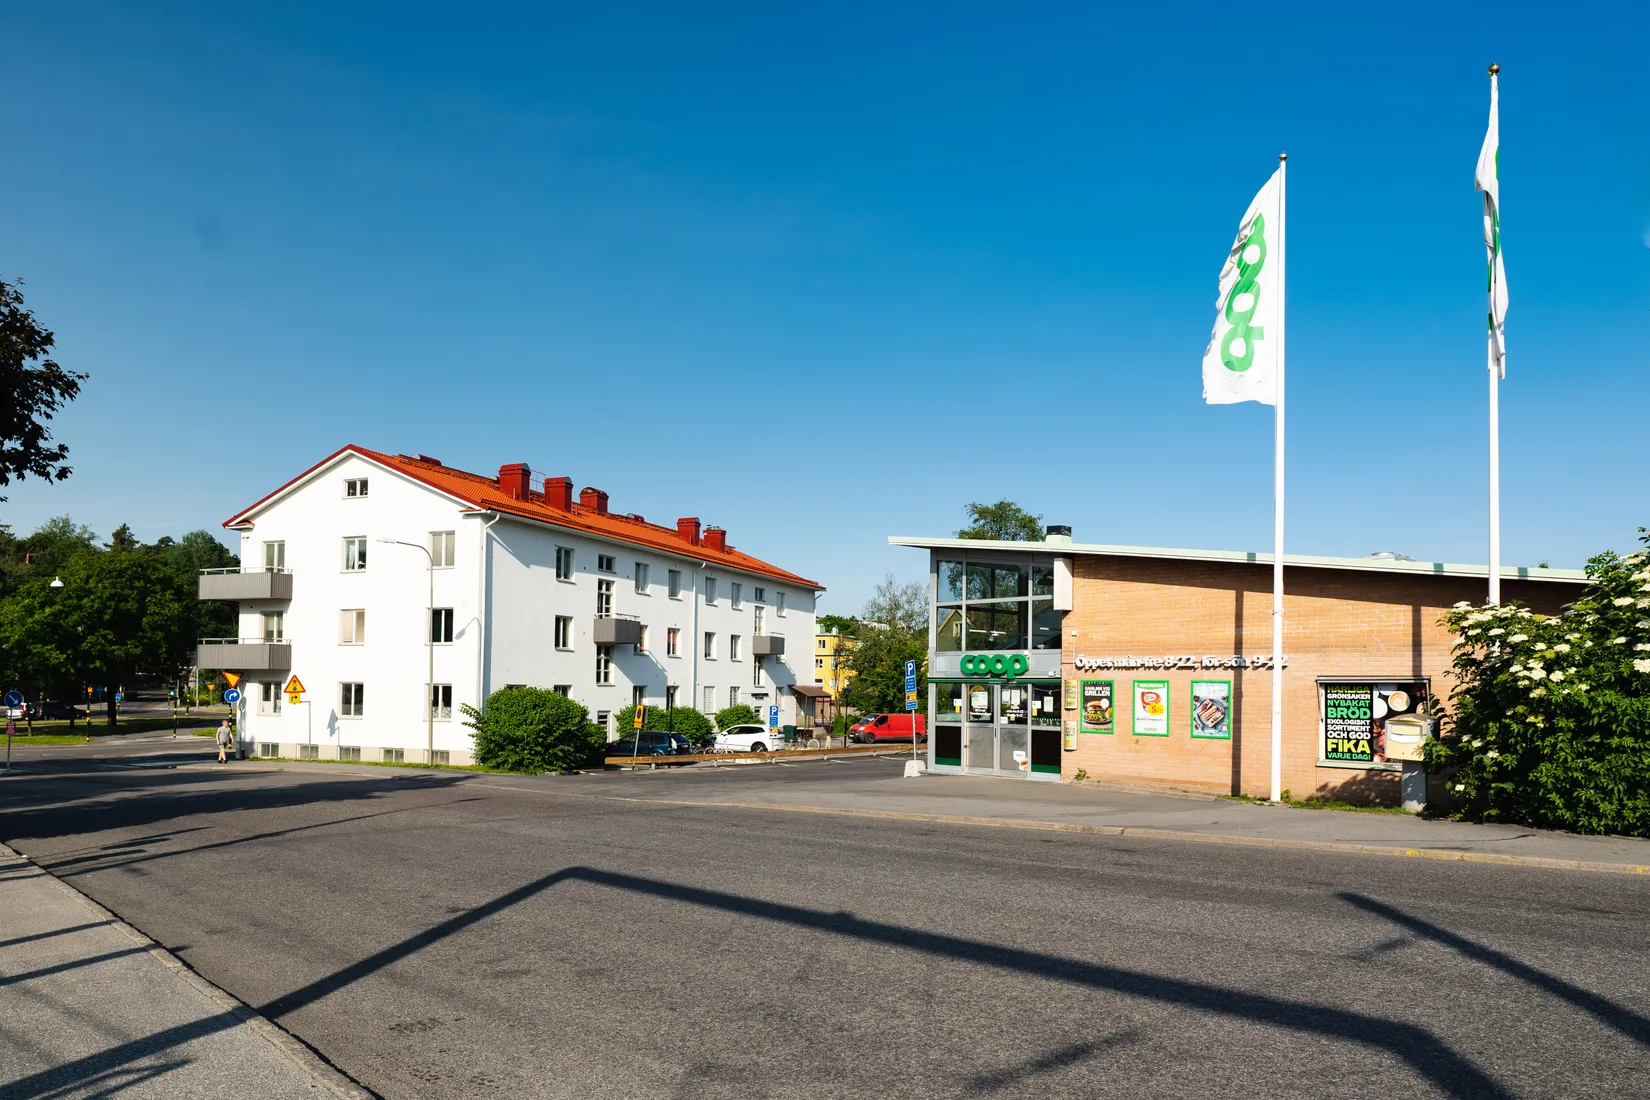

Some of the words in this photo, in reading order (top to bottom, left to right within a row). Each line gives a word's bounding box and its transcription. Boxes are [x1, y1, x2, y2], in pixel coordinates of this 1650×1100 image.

[960, 653, 1030, 680] coop
[1075, 654, 1113, 670] Öppet
[1327, 706, 1371, 719] BRÖD
[1327, 724, 1371, 732] SORTIMENT
[1327, 731, 1348, 739] OCH
[1348, 731, 1371, 740] GOD
[1327, 738, 1371, 753] FIKA
